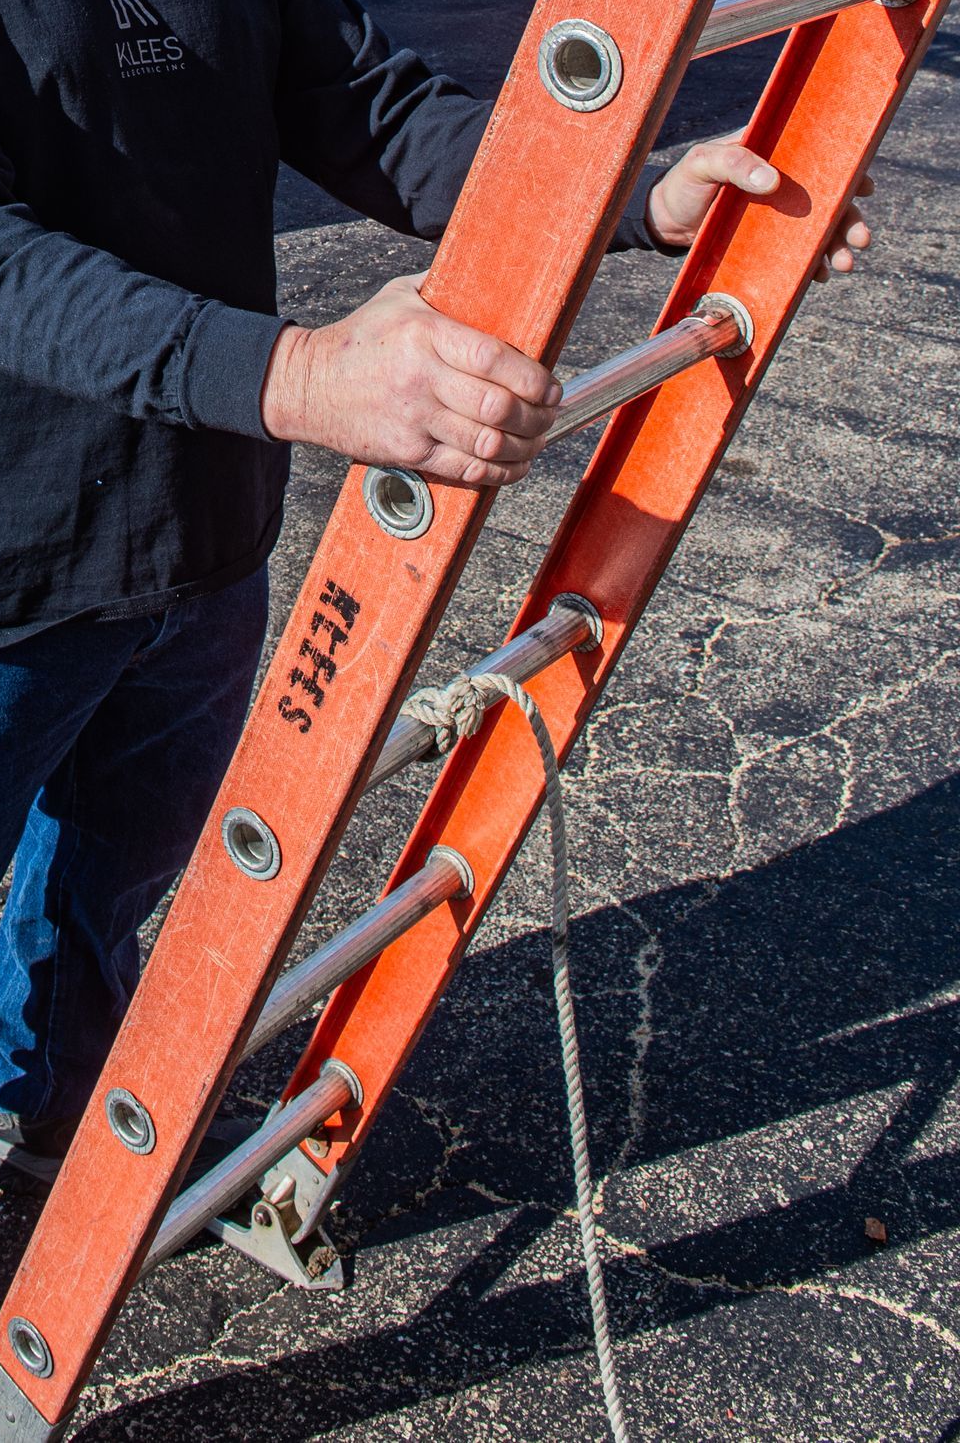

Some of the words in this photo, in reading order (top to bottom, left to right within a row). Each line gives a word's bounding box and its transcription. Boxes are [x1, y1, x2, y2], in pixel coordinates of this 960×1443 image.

[115, 36, 183, 69] KLEES
[120, 66, 162, 79] ELECTRIC
[166, 62, 187, 72] INC
